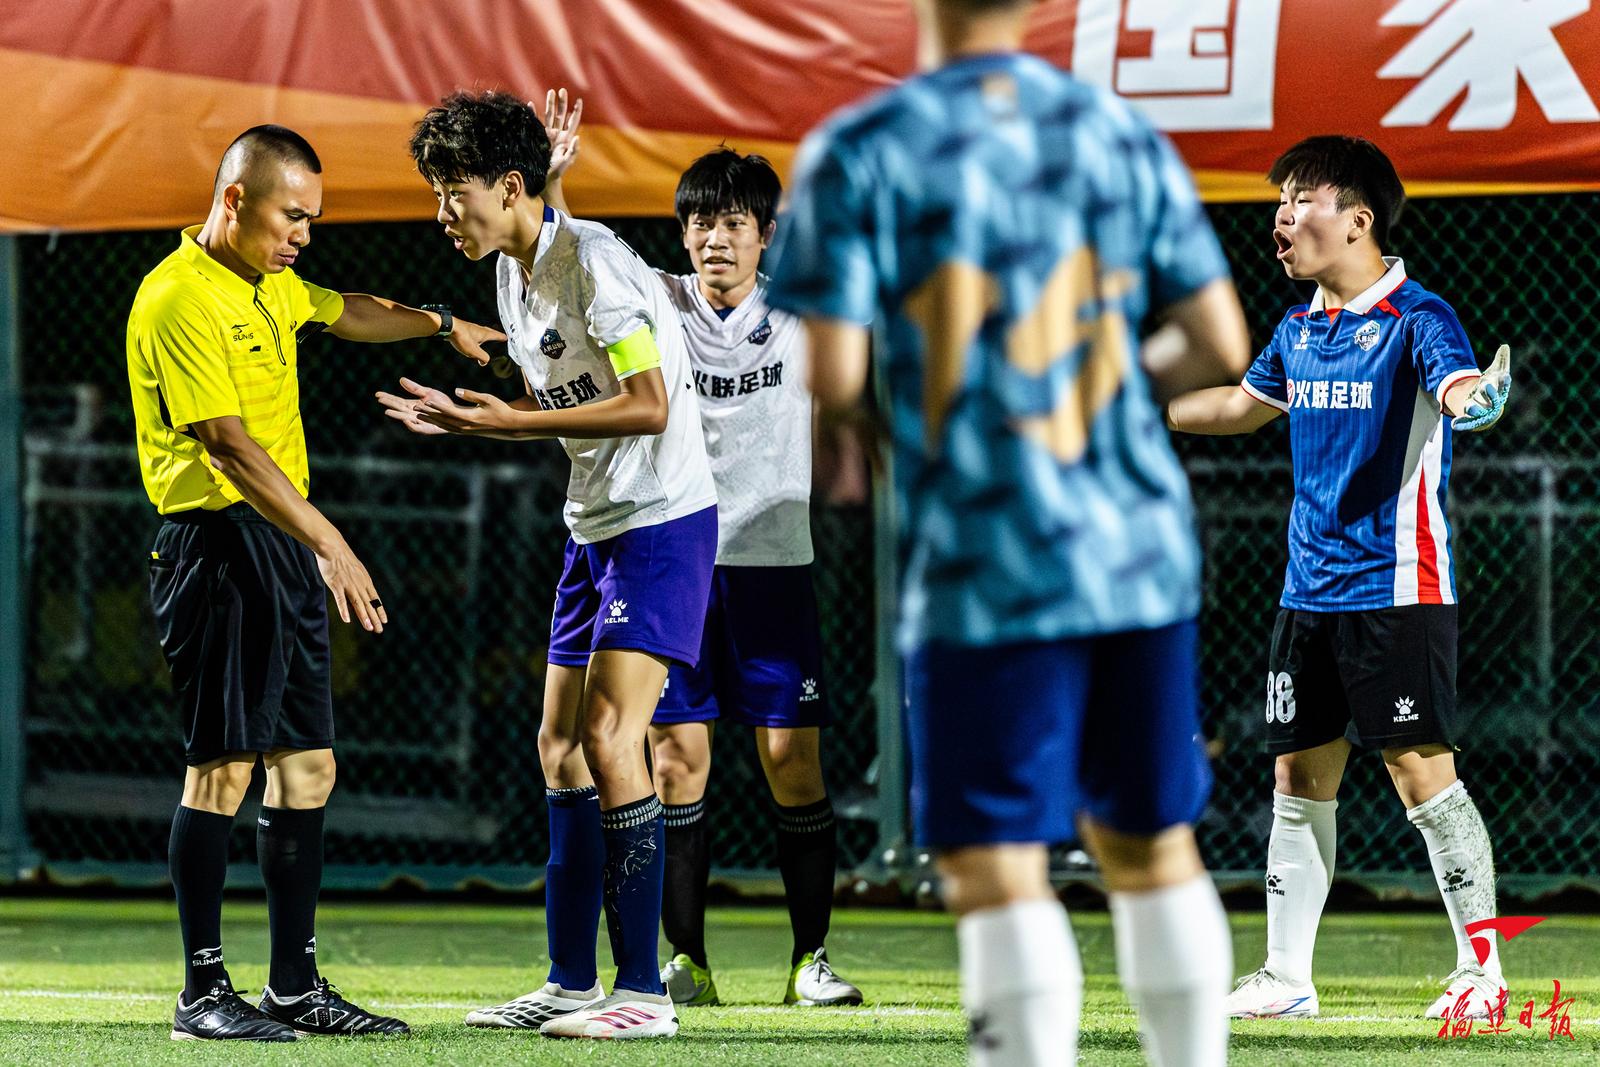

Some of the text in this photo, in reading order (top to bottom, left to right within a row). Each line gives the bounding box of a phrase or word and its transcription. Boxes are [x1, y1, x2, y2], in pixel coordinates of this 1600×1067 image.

[691, 361, 783, 399] 火联足球
[1295, 381, 1372, 410] 火联足球
[604, 616, 630, 624] KELME
[1393, 713, 1419, 723] KELME
[1443, 880, 1475, 893] KELME
